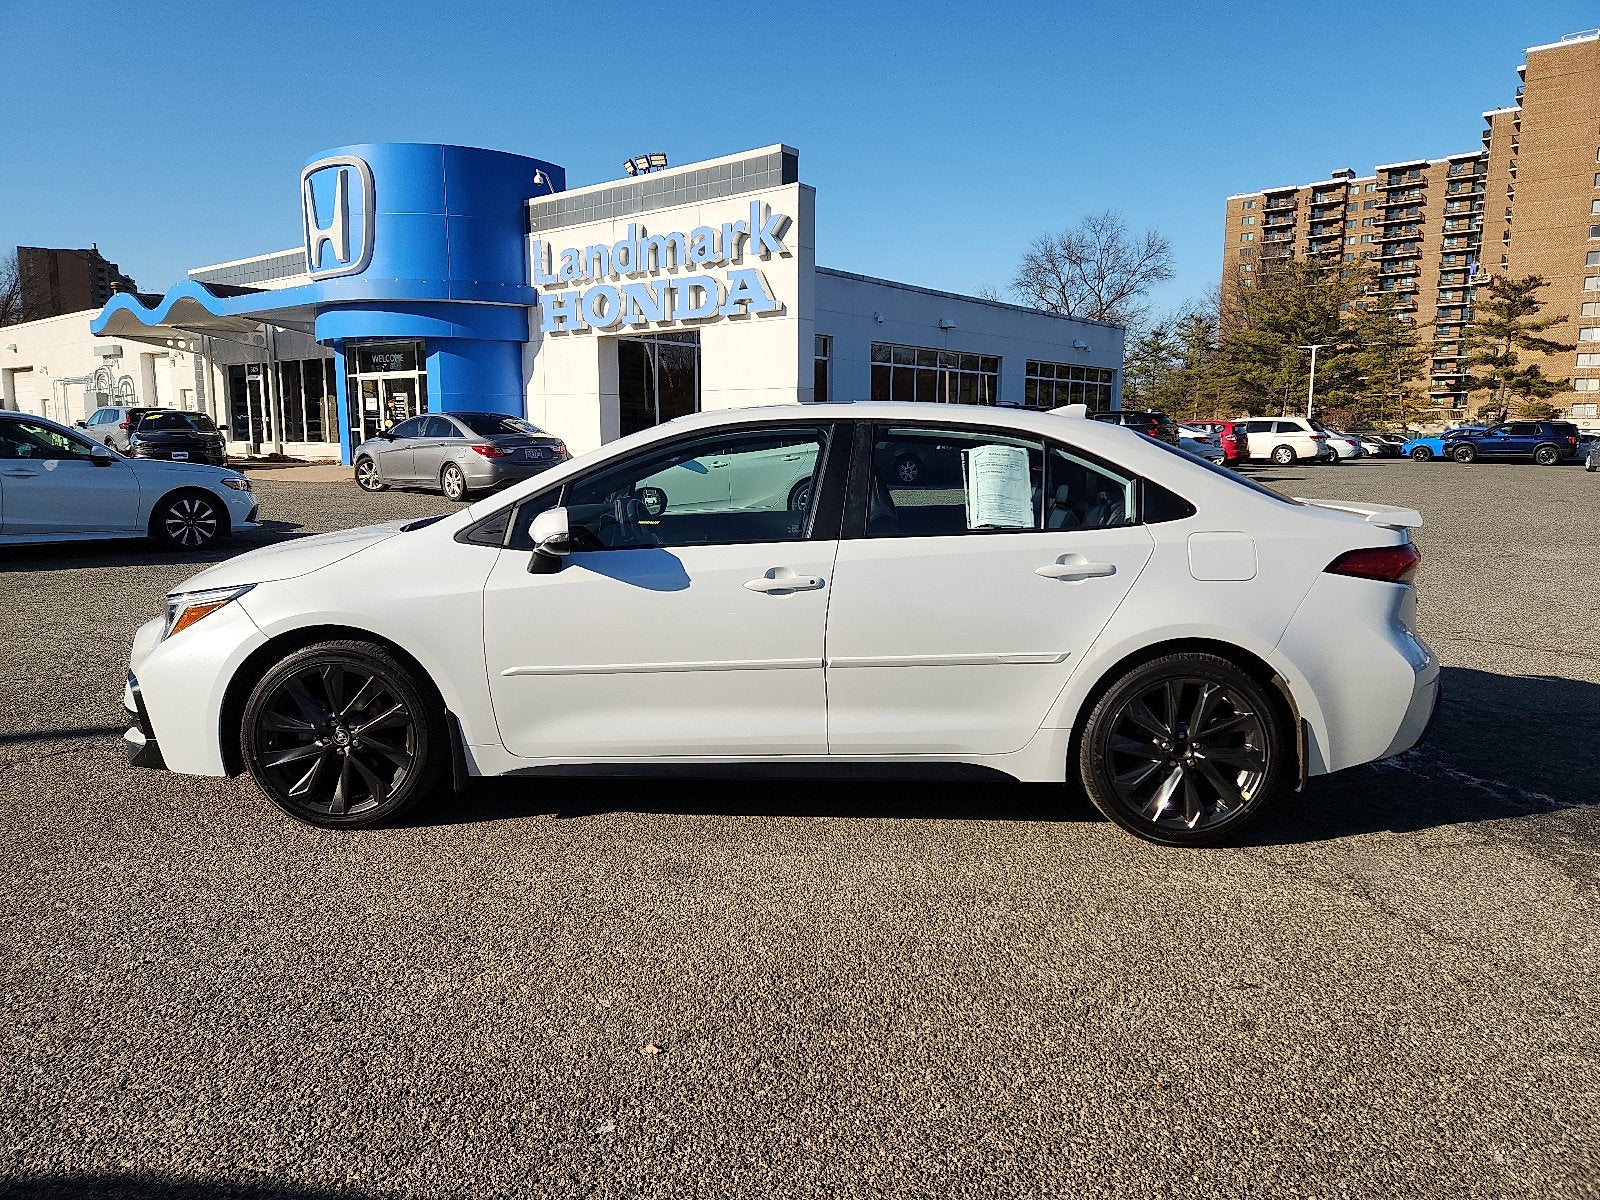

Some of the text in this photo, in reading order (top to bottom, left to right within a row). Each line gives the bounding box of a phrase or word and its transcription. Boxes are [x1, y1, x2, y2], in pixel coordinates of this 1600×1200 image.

[533, 200, 791, 287] Landmark
[539, 268, 784, 334] HONDA
[371, 353, 404, 363] WELCOME
